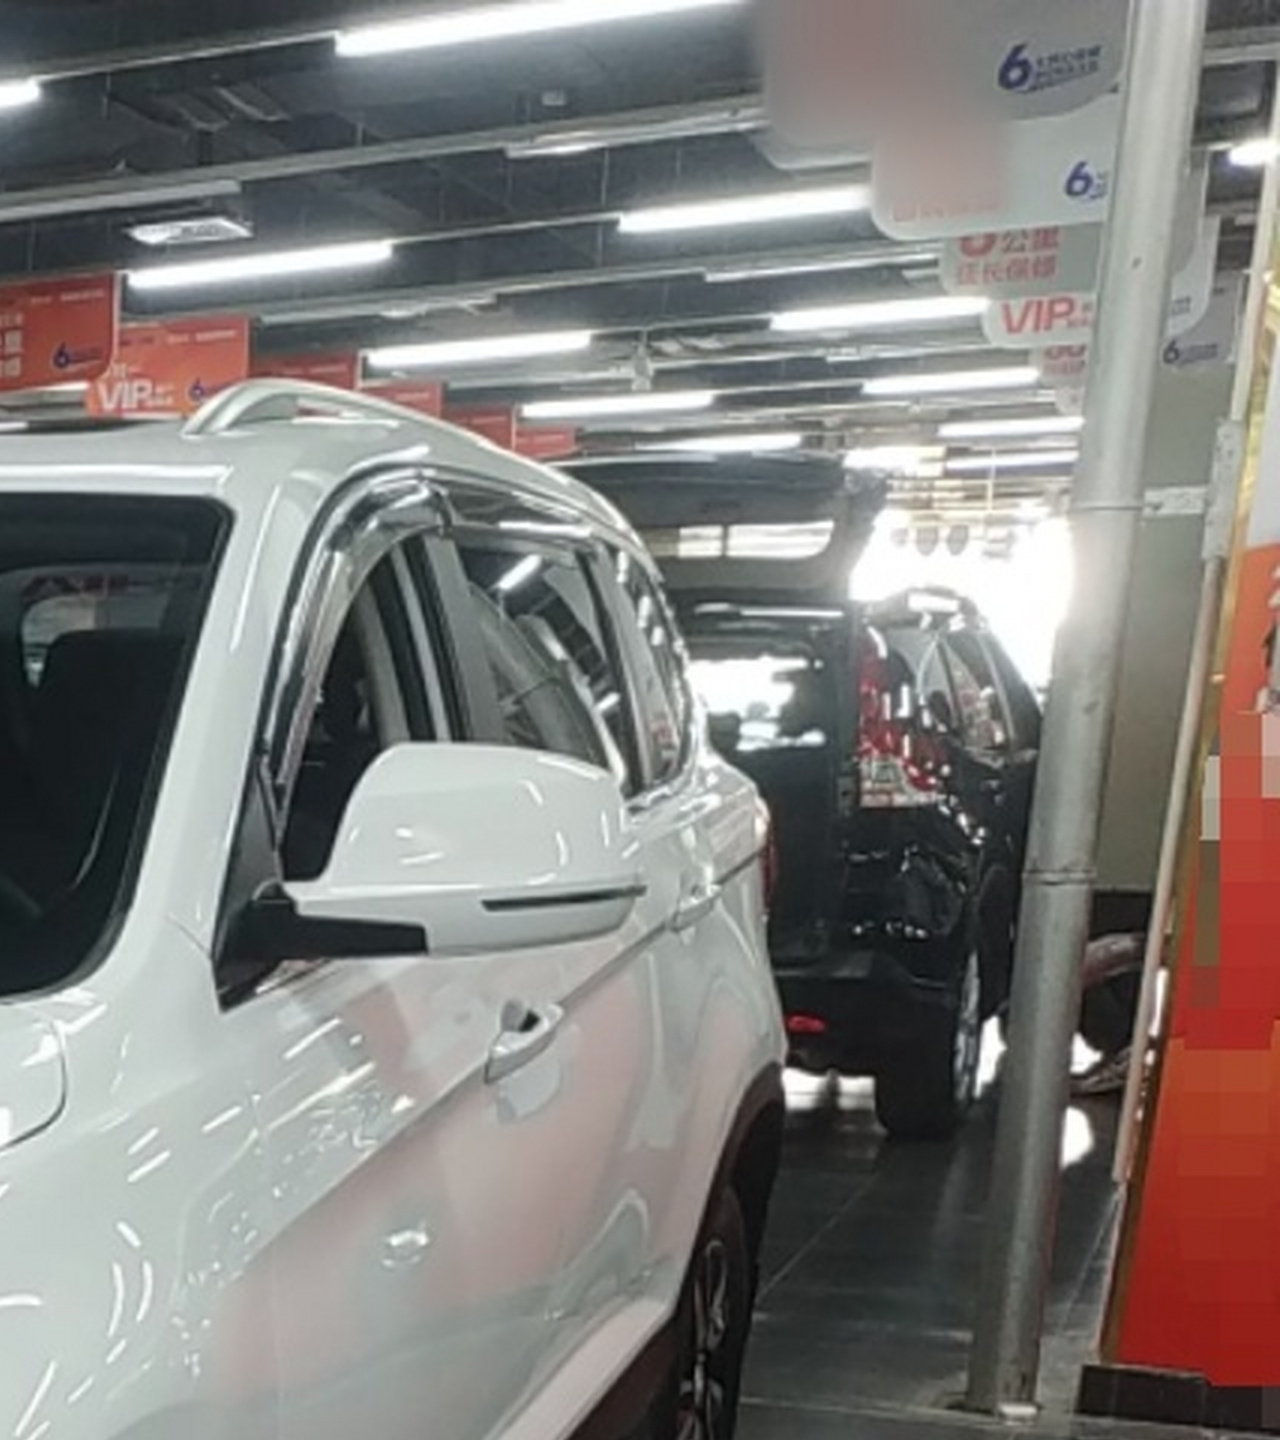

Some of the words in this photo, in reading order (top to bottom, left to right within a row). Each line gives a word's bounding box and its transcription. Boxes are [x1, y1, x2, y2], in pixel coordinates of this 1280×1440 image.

[997, 43, 1032, 91] 6
[1064, 160, 1095, 197] 6
[1001, 297, 1076, 334] VIP
[96, 378, 154, 411] VIP
